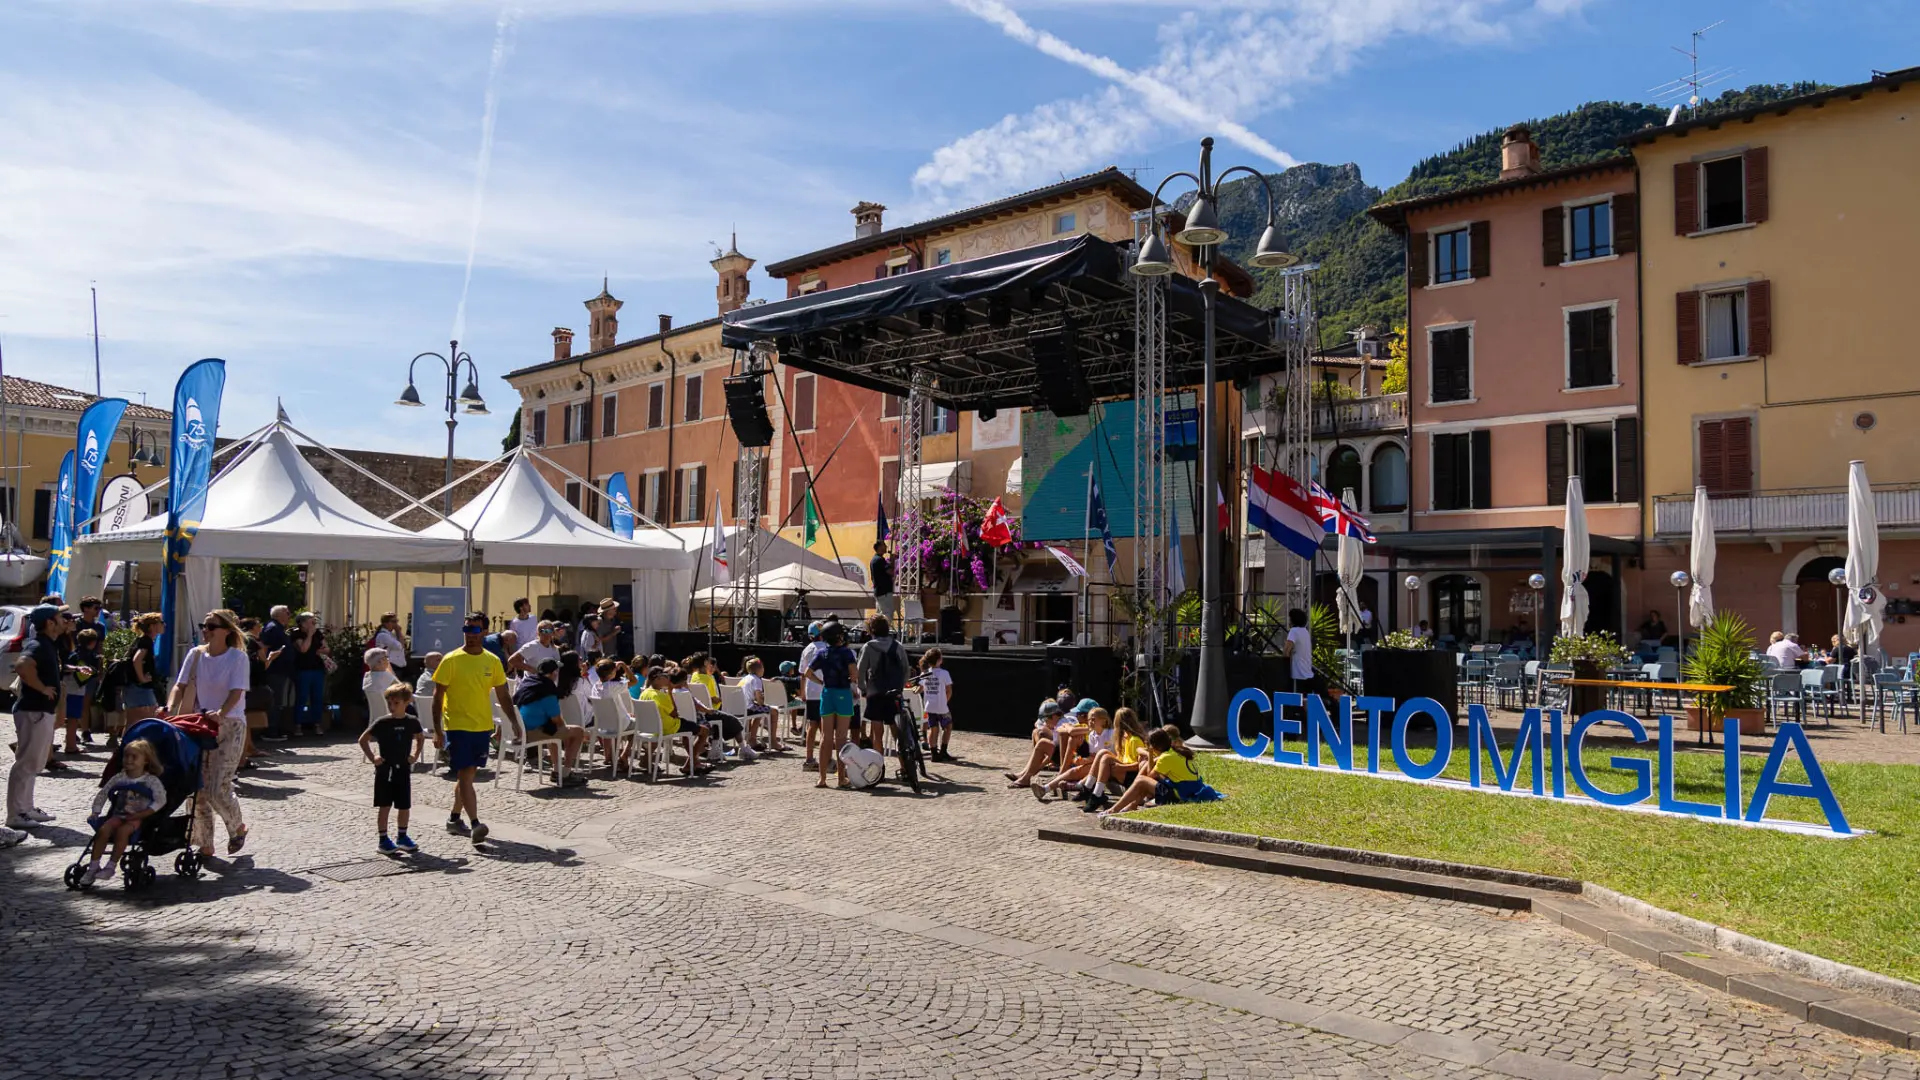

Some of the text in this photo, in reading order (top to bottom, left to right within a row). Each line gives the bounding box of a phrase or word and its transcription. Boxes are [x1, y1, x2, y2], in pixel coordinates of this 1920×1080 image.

[189, 422, 206, 436] 75
[1227, 687, 1854, 835] CENTO MIGLIA
